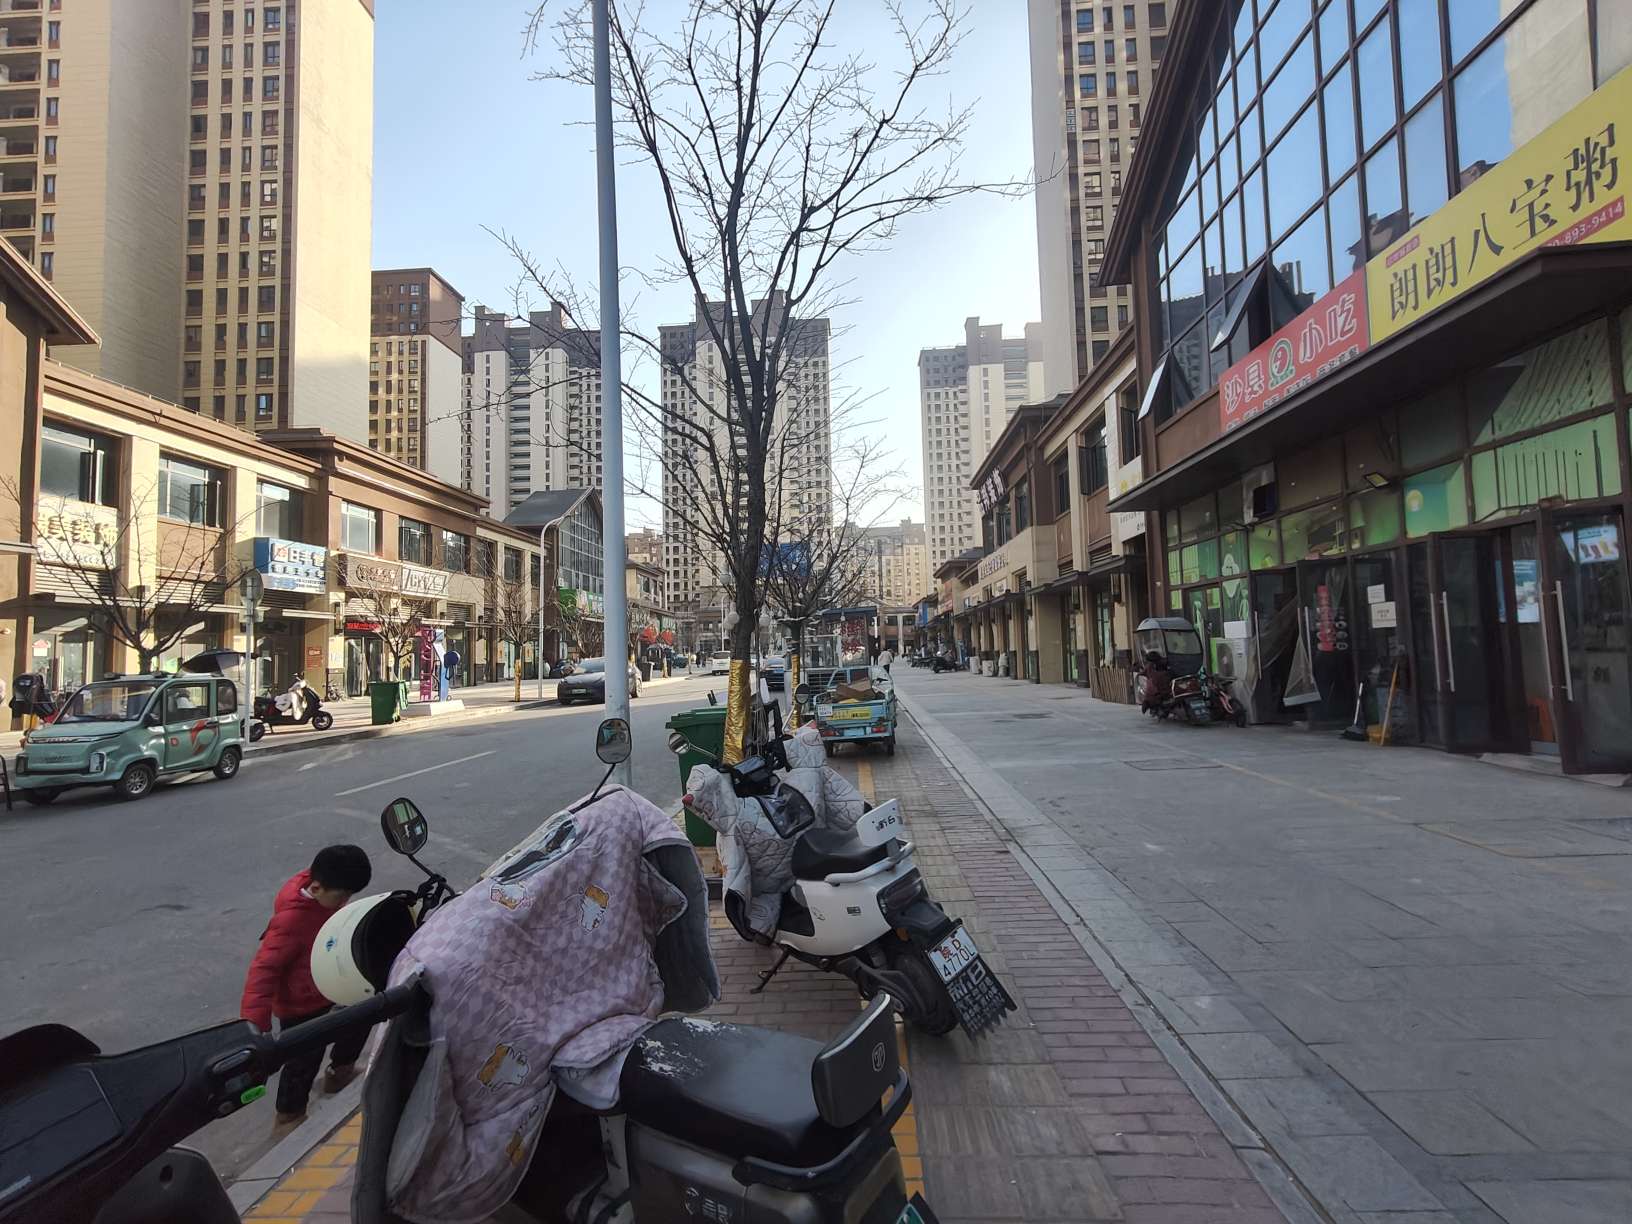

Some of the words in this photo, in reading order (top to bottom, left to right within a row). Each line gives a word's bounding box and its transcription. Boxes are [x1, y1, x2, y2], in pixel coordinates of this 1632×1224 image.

[1389, 122, 1619, 322] 朗朗八宝粥
